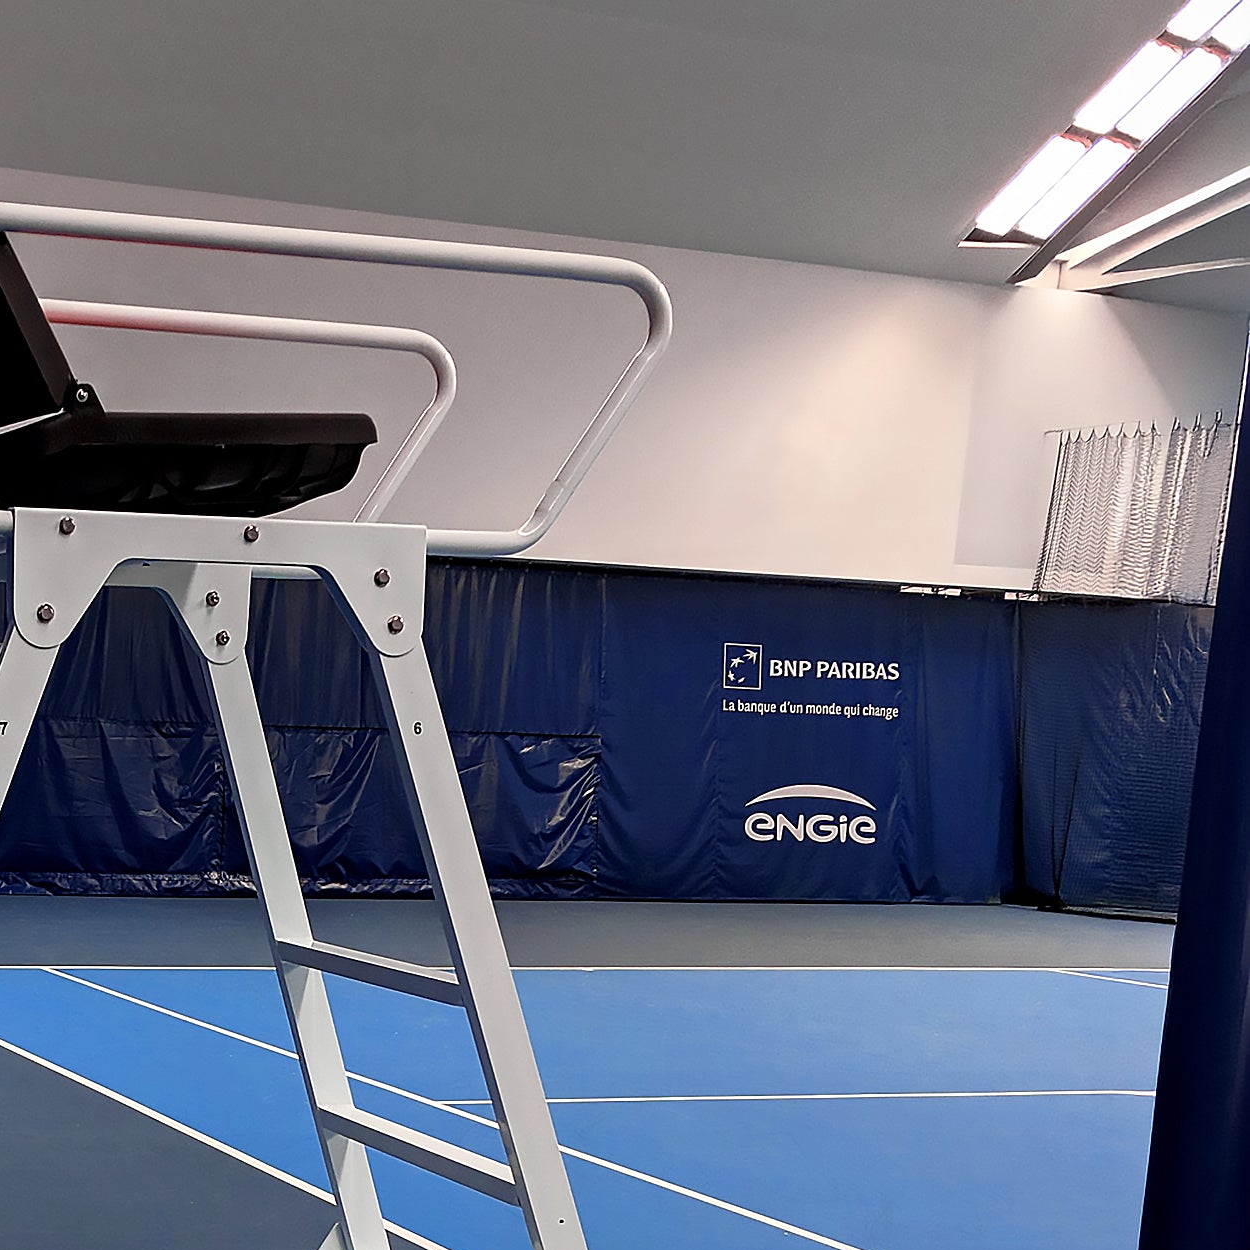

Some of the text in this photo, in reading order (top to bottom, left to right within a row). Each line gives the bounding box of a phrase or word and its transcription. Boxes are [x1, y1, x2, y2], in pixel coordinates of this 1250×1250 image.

[769, 659, 900, 680] BNP PARIBAS
[722, 699, 736, 712] La
[737, 699, 777, 716] banque
[805, 702, 842, 716] monde
[844, 703, 860, 719] qui
[862, 704, 899, 721] change
[0, 721, 9, 736] 7
[413, 721, 423, 735] 6
